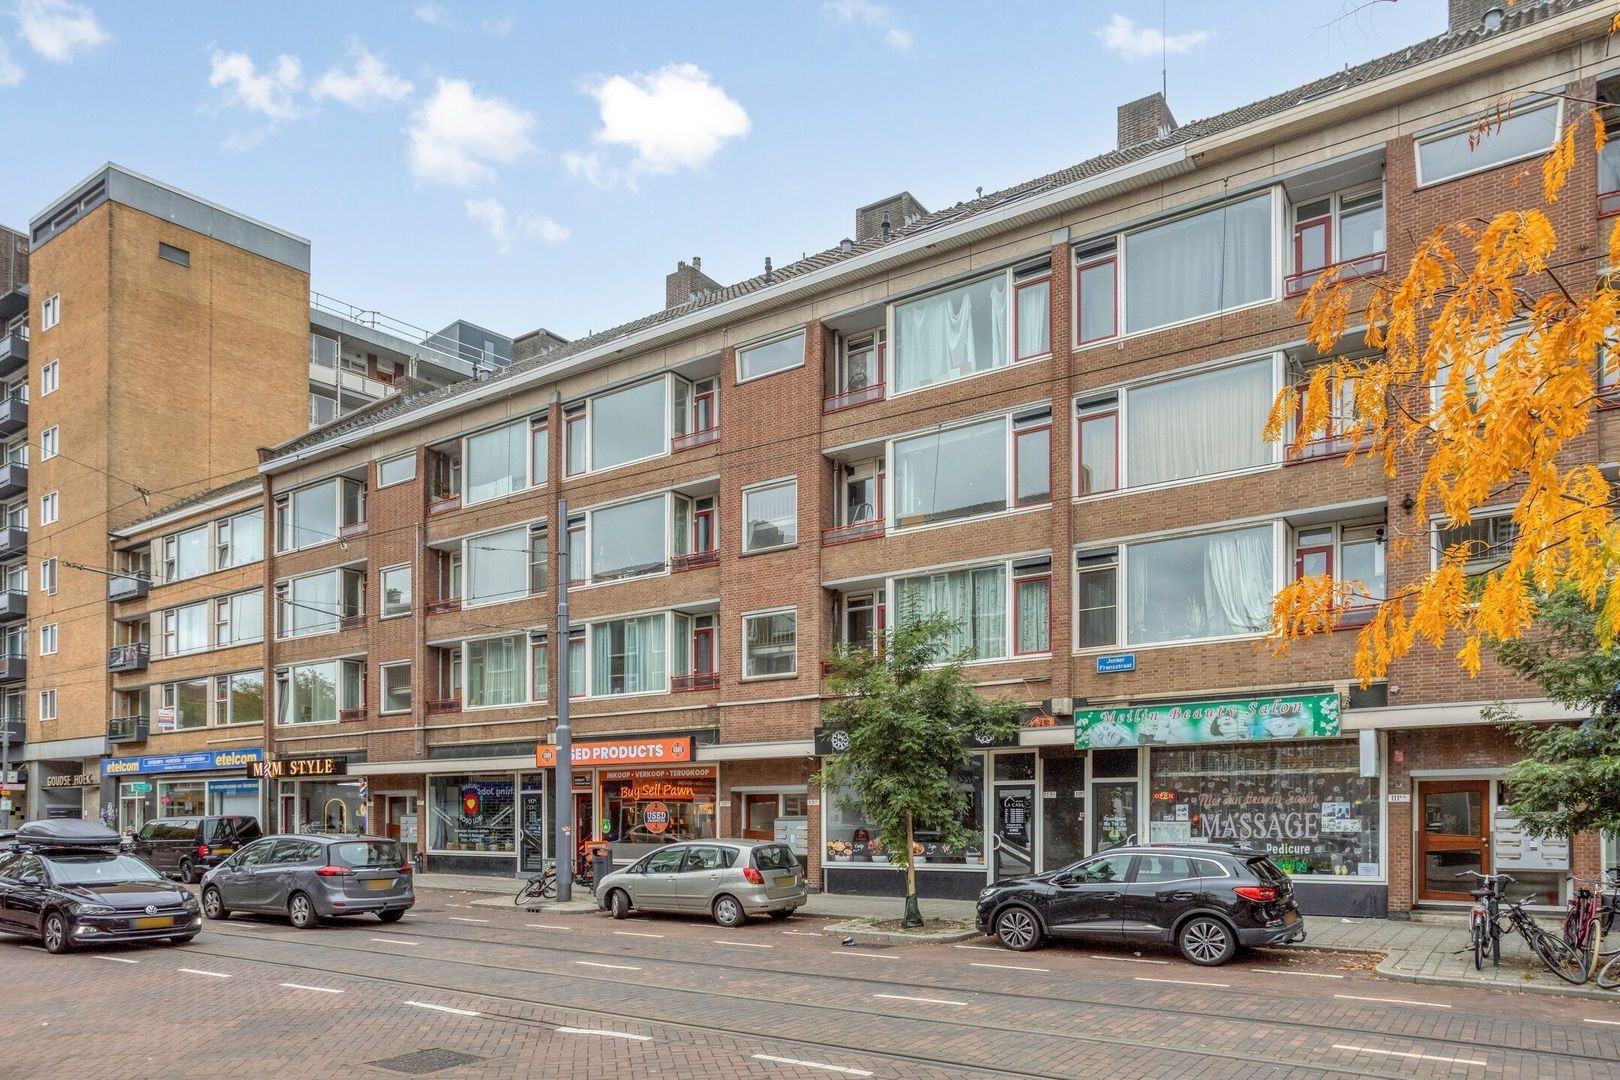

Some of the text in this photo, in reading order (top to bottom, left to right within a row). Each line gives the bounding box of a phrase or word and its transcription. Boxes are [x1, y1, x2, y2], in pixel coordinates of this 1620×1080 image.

[1100, 699, 1303, 724] Meilin Beauty Salon
[216, 752, 257, 766] etelcom
[570, 748, 590, 760] SED
[592, 744, 664, 759] PRODUCTS
[106, 762, 139, 772] etelcom
[290, 759, 332, 775] STYLE
[670, 769, 710, 777] TERUGKOOP
[47, 776, 71, 786] GOUDSE
[620, 783, 694, 800] Buy Sell Pawn
[1284, 790, 1318, 804] Salon
[647, 811, 666, 820] USED
[1200, 812, 1321, 839] MASSAGE
[1266, 843, 1310, 854] Pedicure
